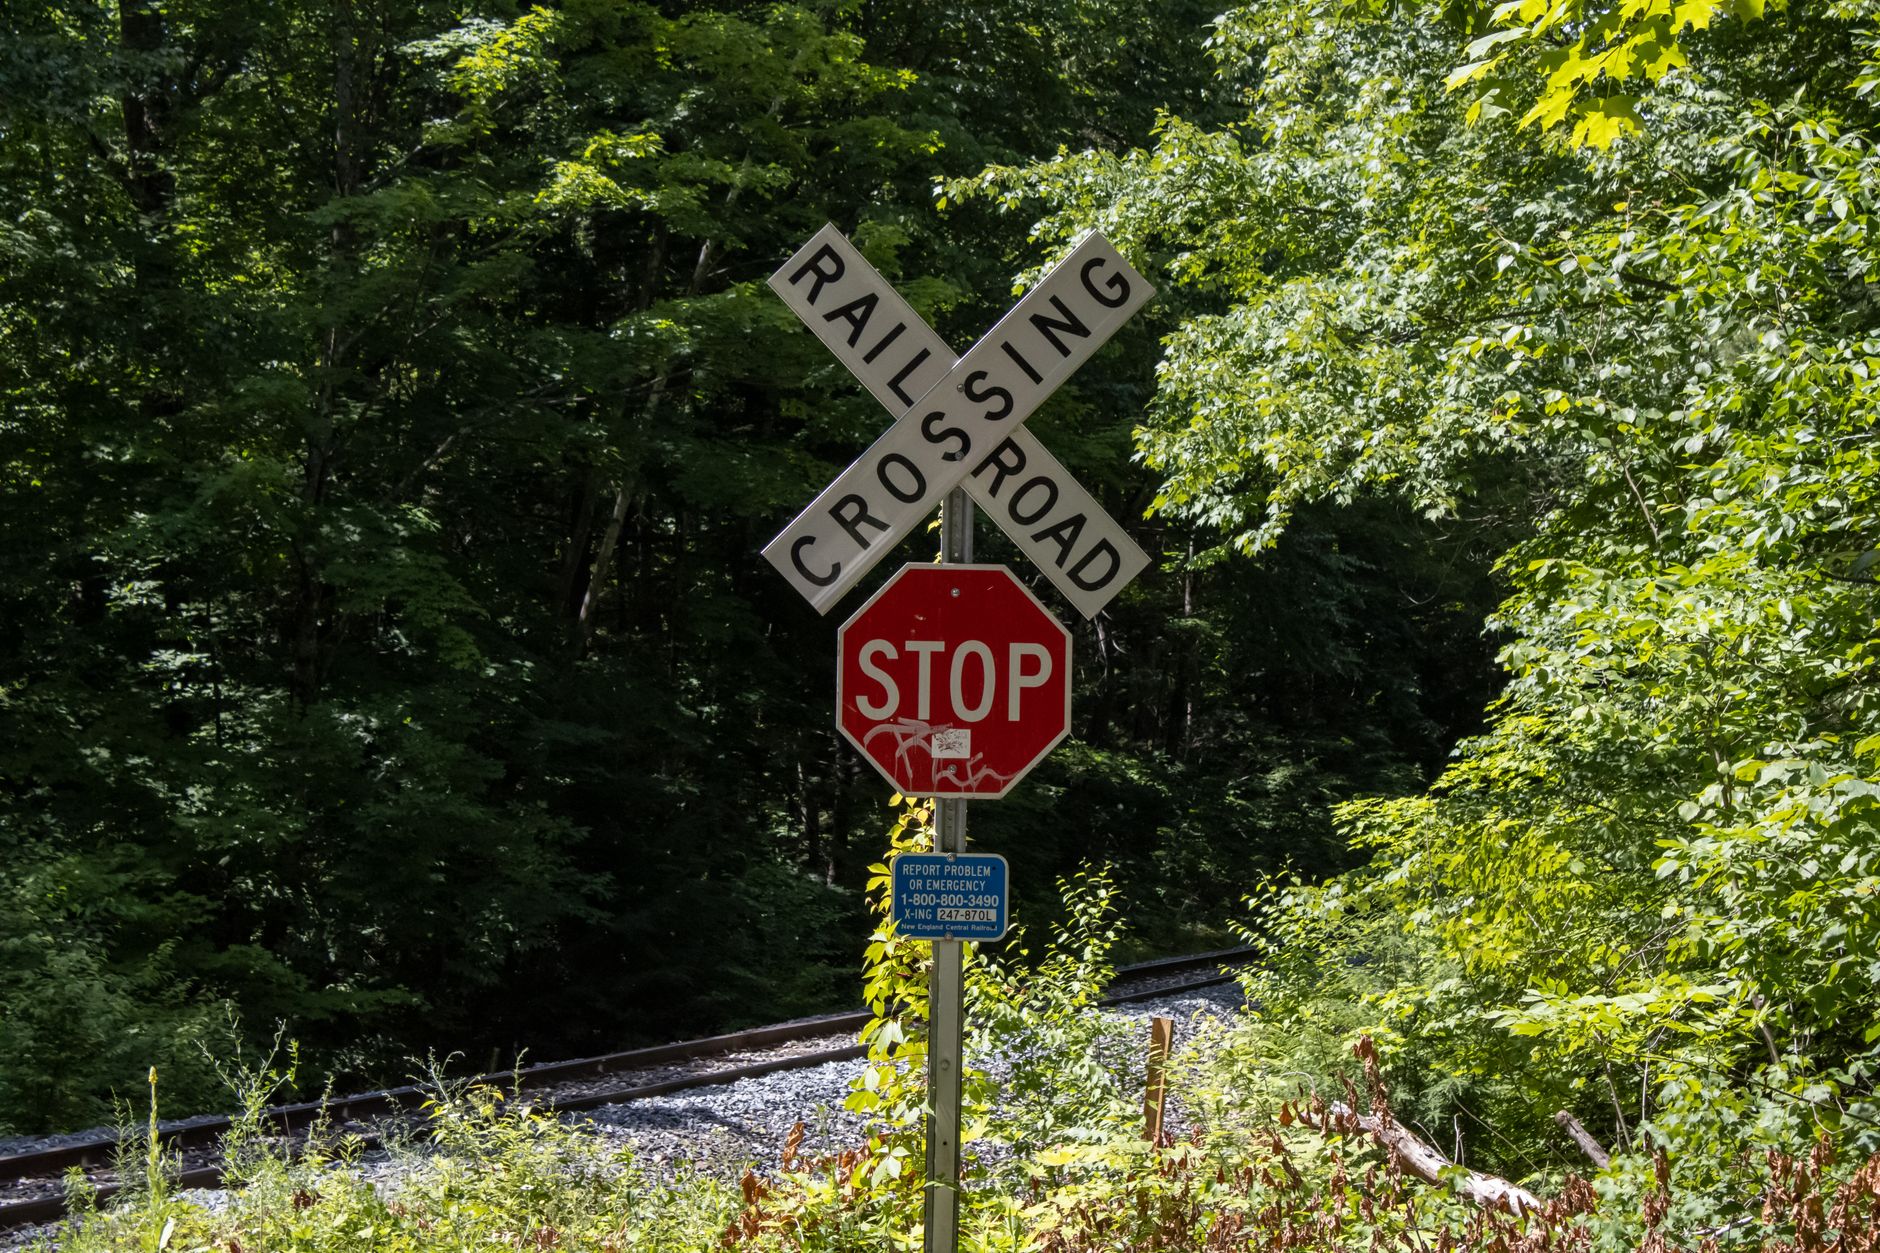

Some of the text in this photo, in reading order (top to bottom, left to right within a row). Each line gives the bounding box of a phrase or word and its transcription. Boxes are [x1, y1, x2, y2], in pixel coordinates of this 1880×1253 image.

[789, 243, 1121, 592] RAIL ROAD
[790, 257, 1131, 587] CROSSING
[855, 639, 1053, 723] STOP
[902, 864, 991, 877] REPORT PROBLEM
[909, 879, 986, 891] OR EMERGENCY
[901, 893, 999, 907] 1-800-800-3490
[904, 908, 992, 921] X-ING 247-870L
[917, 923, 943, 931] England
